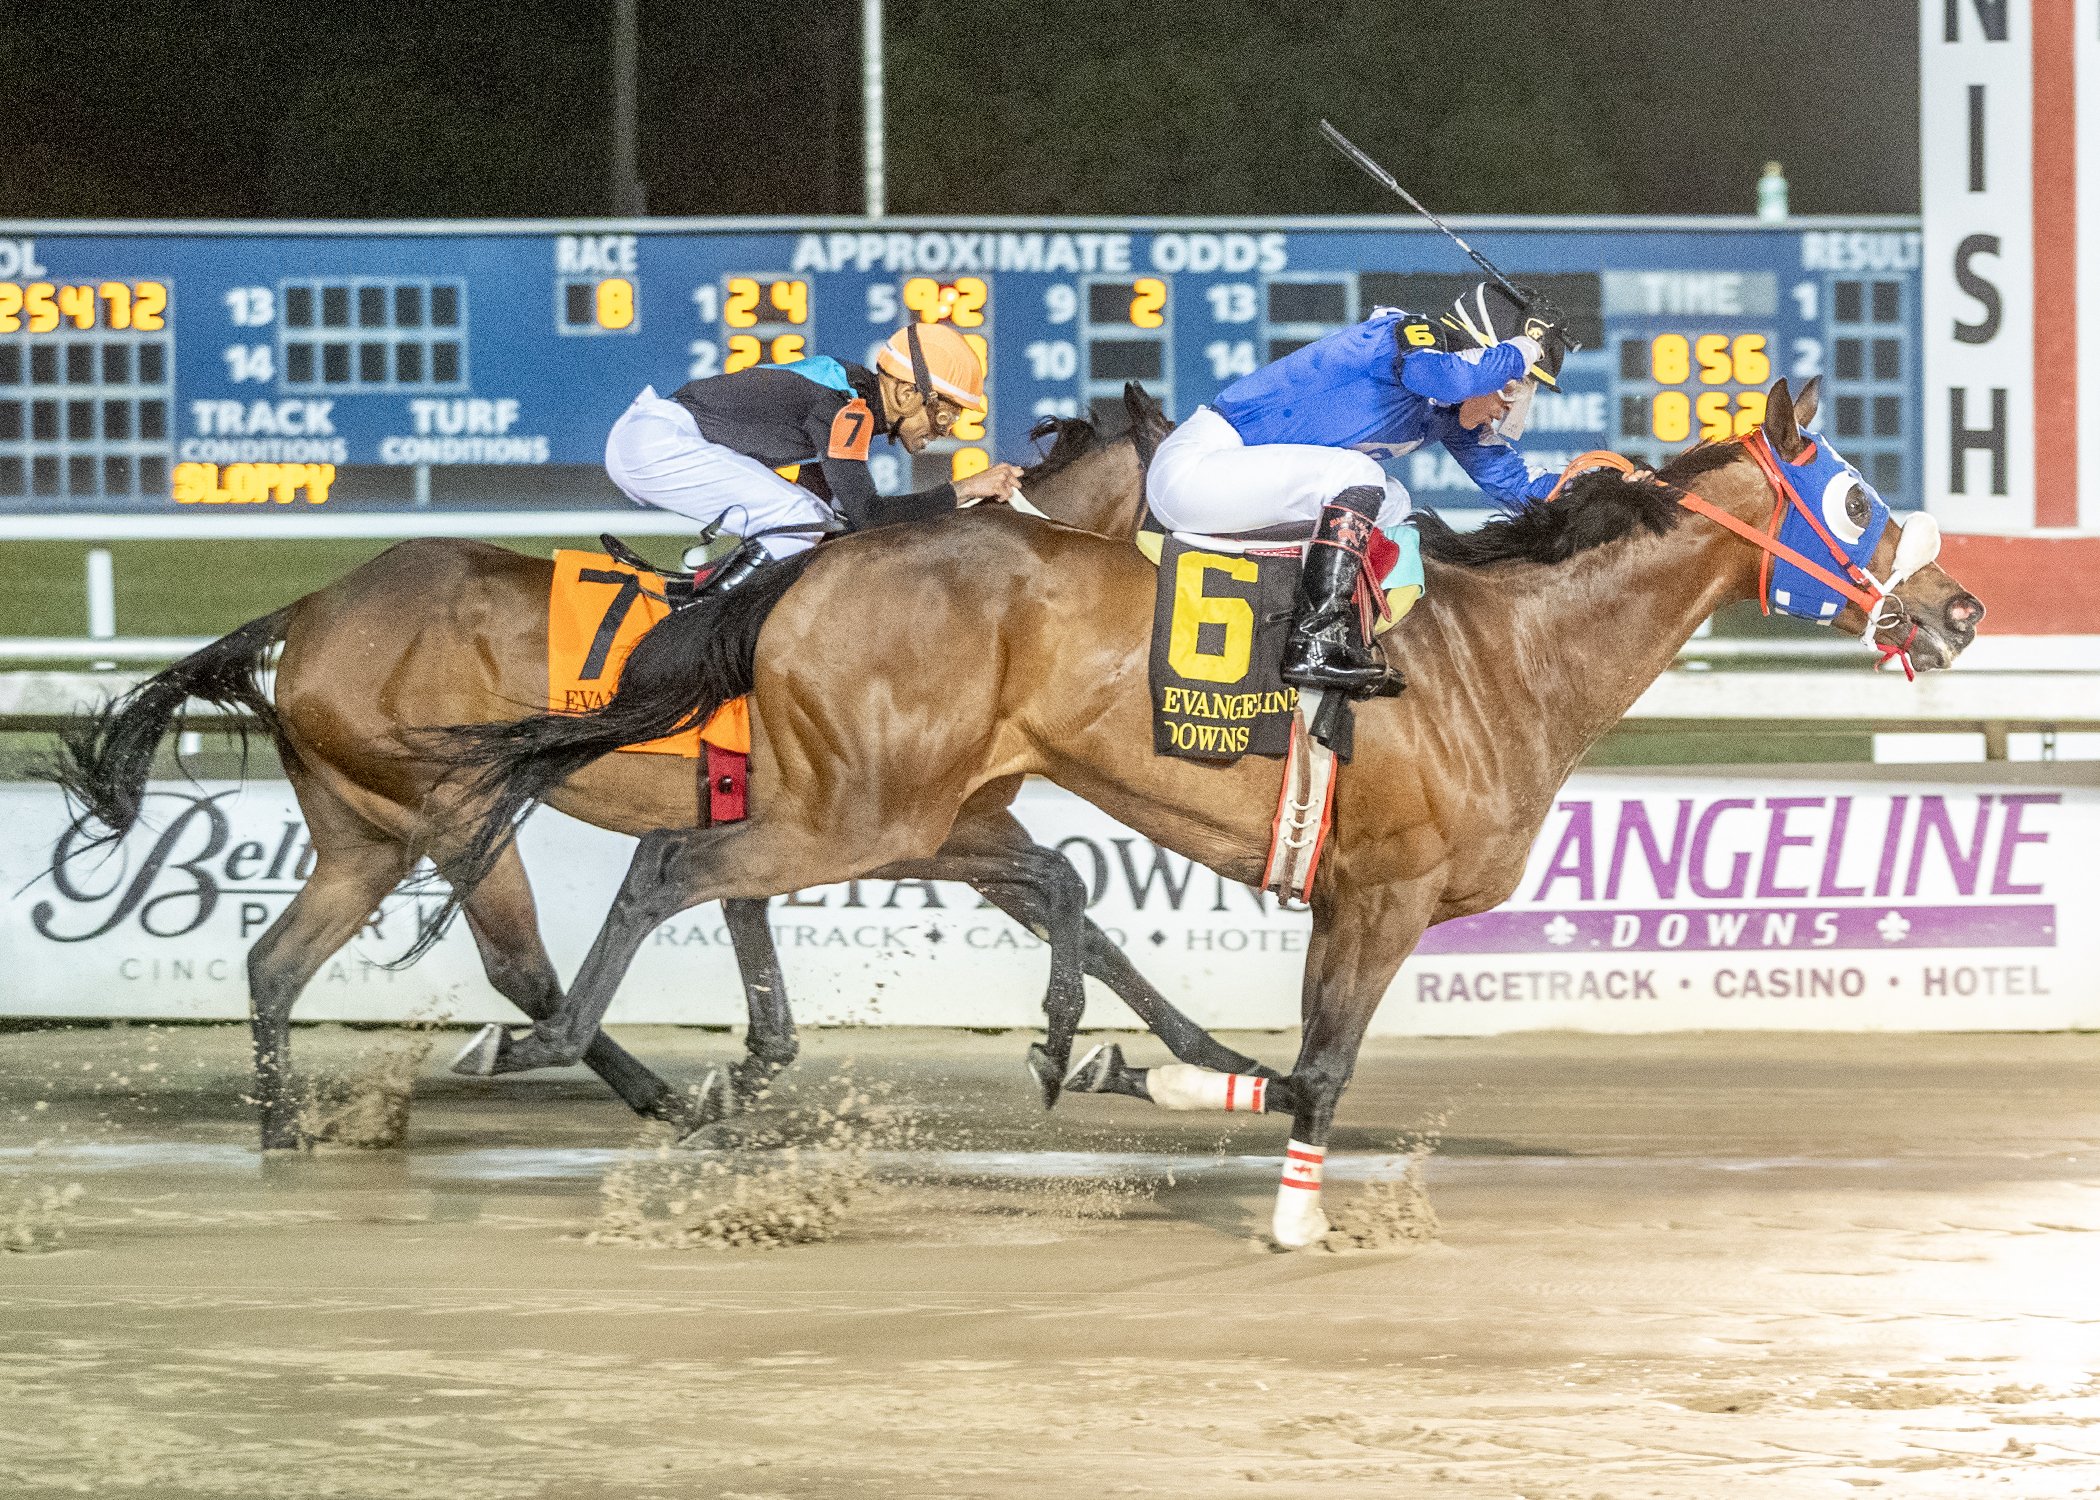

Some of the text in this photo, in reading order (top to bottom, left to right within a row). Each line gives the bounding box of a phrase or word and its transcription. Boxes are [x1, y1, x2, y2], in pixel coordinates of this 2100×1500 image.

[556, 237, 637, 272] RACE
[791, 234, 1288, 273] APPROXIMATE ODDS
[226, 287, 274, 327] 13
[596, 278, 635, 329] 8
[693, 284, 717, 322] 1
[866, 284, 898, 323] 5
[1045, 284, 1076, 323] 9
[1130, 278, 1167, 328] 2
[1206, 284, 1257, 323] 13
[1638, 273, 1743, 316] TIME
[1793, 282, 1818, 321] 1
[1404, 324, 1435, 346] 6
[224, 346, 275, 384] 14
[689, 340, 718, 379] 2
[1027, 342, 1076, 381] 10
[1204, 341, 1257, 380] 14
[1791, 338, 1822, 378] 2
[192, 401, 335, 435] TRACK
[409, 401, 520, 435] TURF
[845, 412, 868, 448] 7
[180, 437, 348, 463] CONDITIONS
[381, 437, 550, 464] CONDITIONS
[172, 463, 336, 504] SLOPPY
[578, 568, 643, 681] 7
[1167, 551, 1259, 684] 6
[1530, 793, 2063, 902] ANGELINE
[655, 923, 910, 949] RACTRACK
[1186, 929, 1312, 952] HOTE
[1611, 912, 1839, 948] DOWNS
[1416, 966, 2051, 1003] RACETRACK CASINO HOTEL
